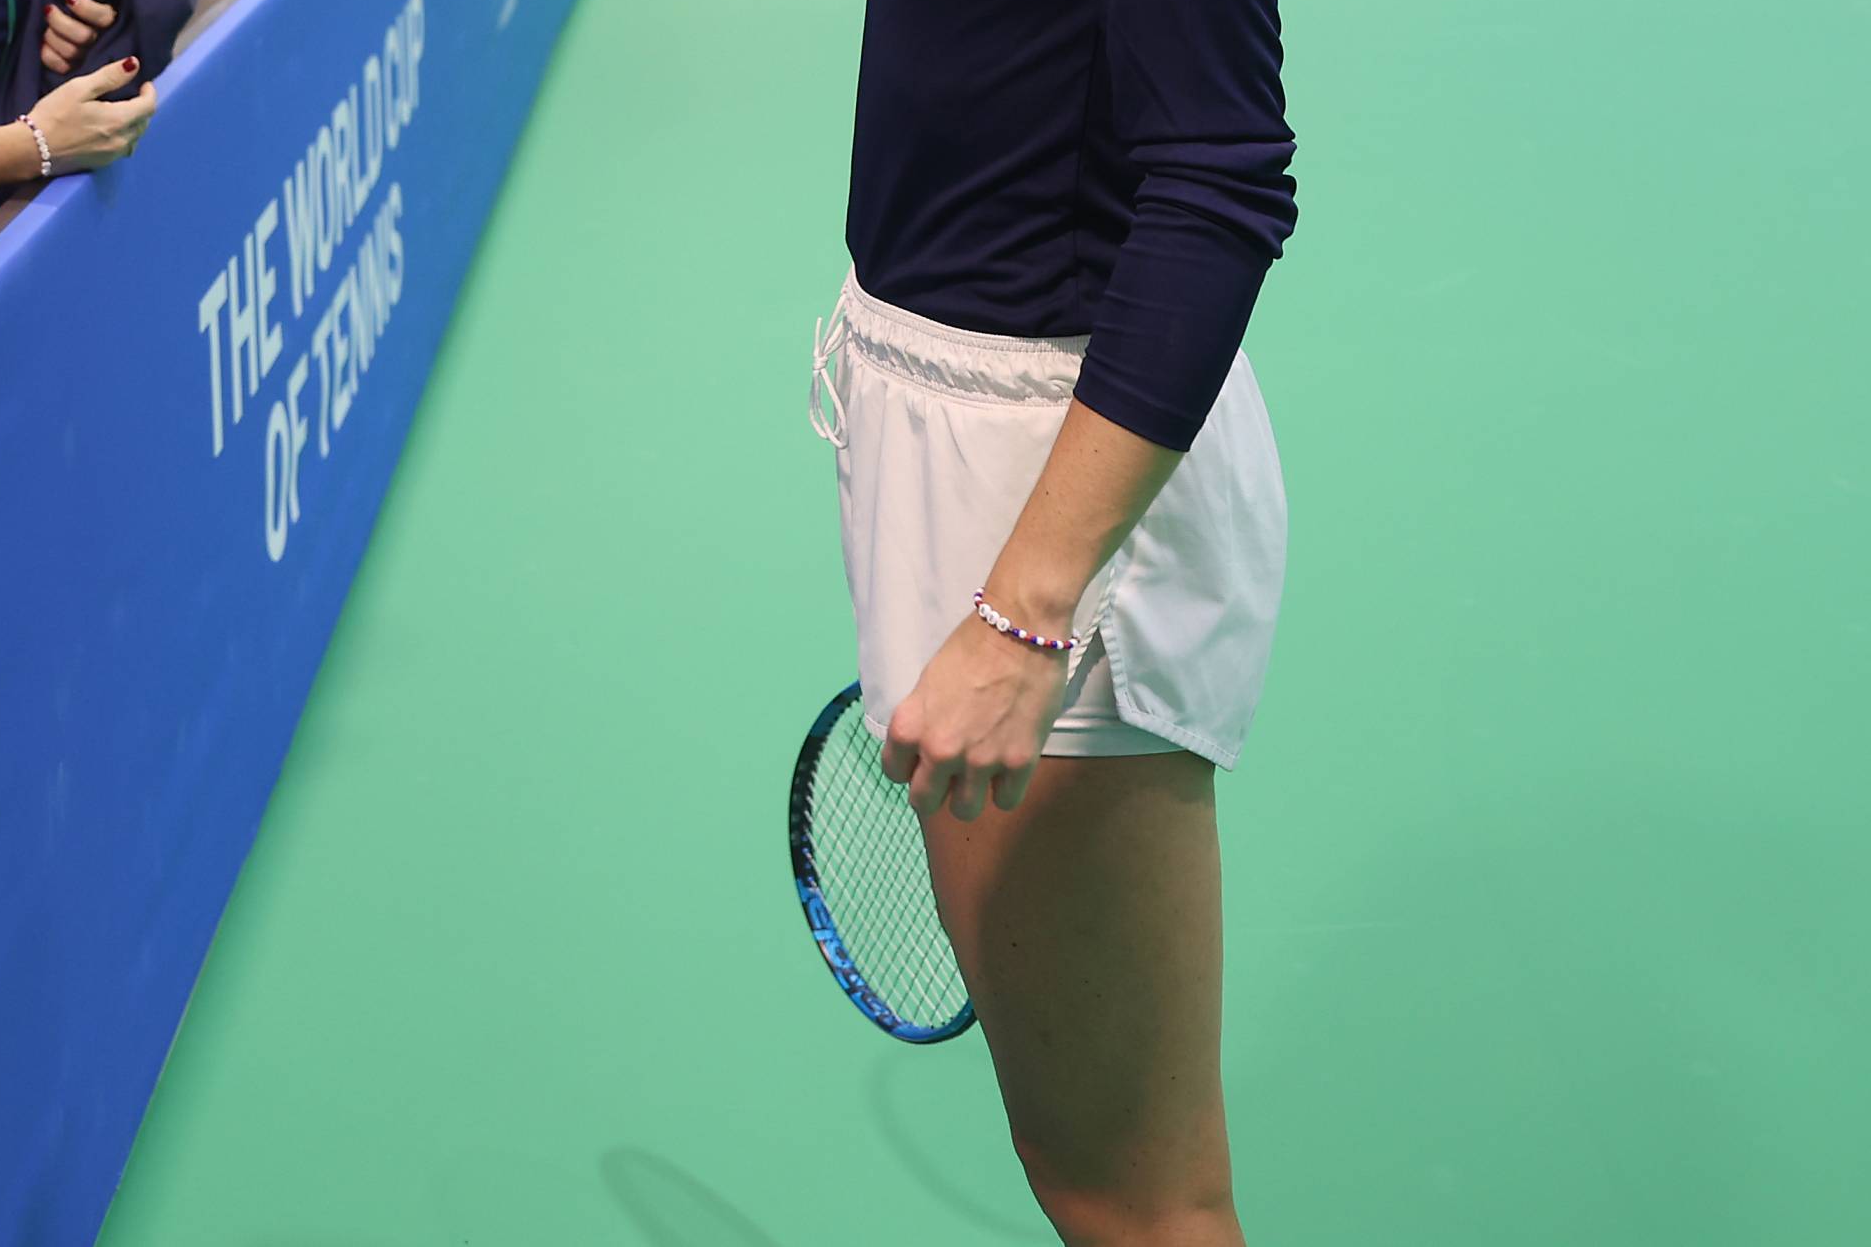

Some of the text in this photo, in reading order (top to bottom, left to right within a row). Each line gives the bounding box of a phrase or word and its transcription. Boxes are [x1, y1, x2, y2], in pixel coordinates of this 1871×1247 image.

[199, 198, 283, 458] THE
[284, 54, 382, 319] WORLD
[265, 182, 404, 562] OF TENNIS
